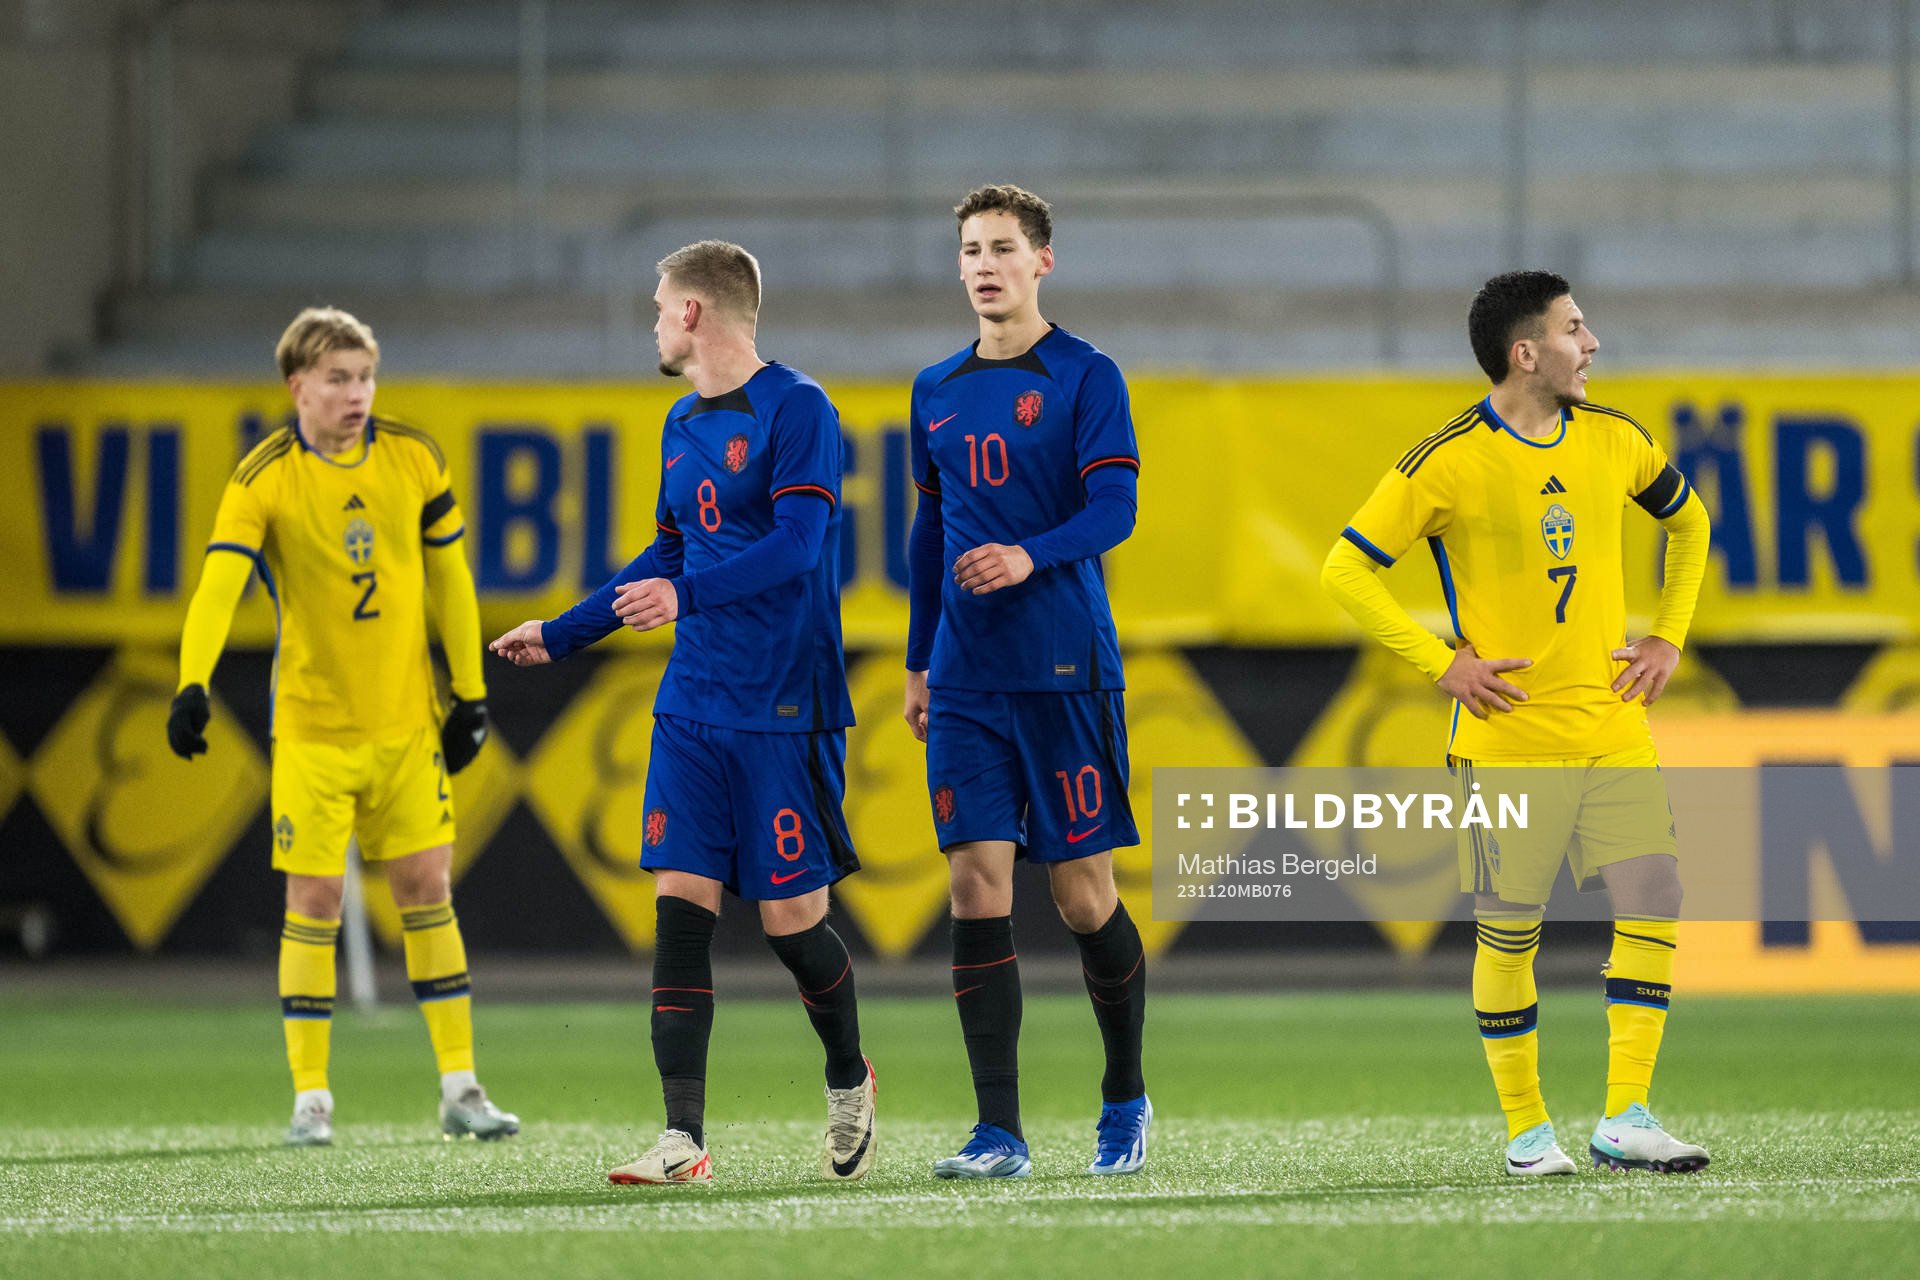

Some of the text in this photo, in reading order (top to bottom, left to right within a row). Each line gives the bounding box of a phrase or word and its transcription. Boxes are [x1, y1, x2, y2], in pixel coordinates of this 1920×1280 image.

[963, 432, 1010, 488] 10
[35, 424, 183, 593] VI
[697, 479, 722, 533] 8
[1656, 402, 1869, 590] ÄR
[351, 570, 381, 621] 2
[1547, 565, 1577, 624] 7
[1054, 764, 1102, 823] 10
[772, 808, 805, 862] 8
